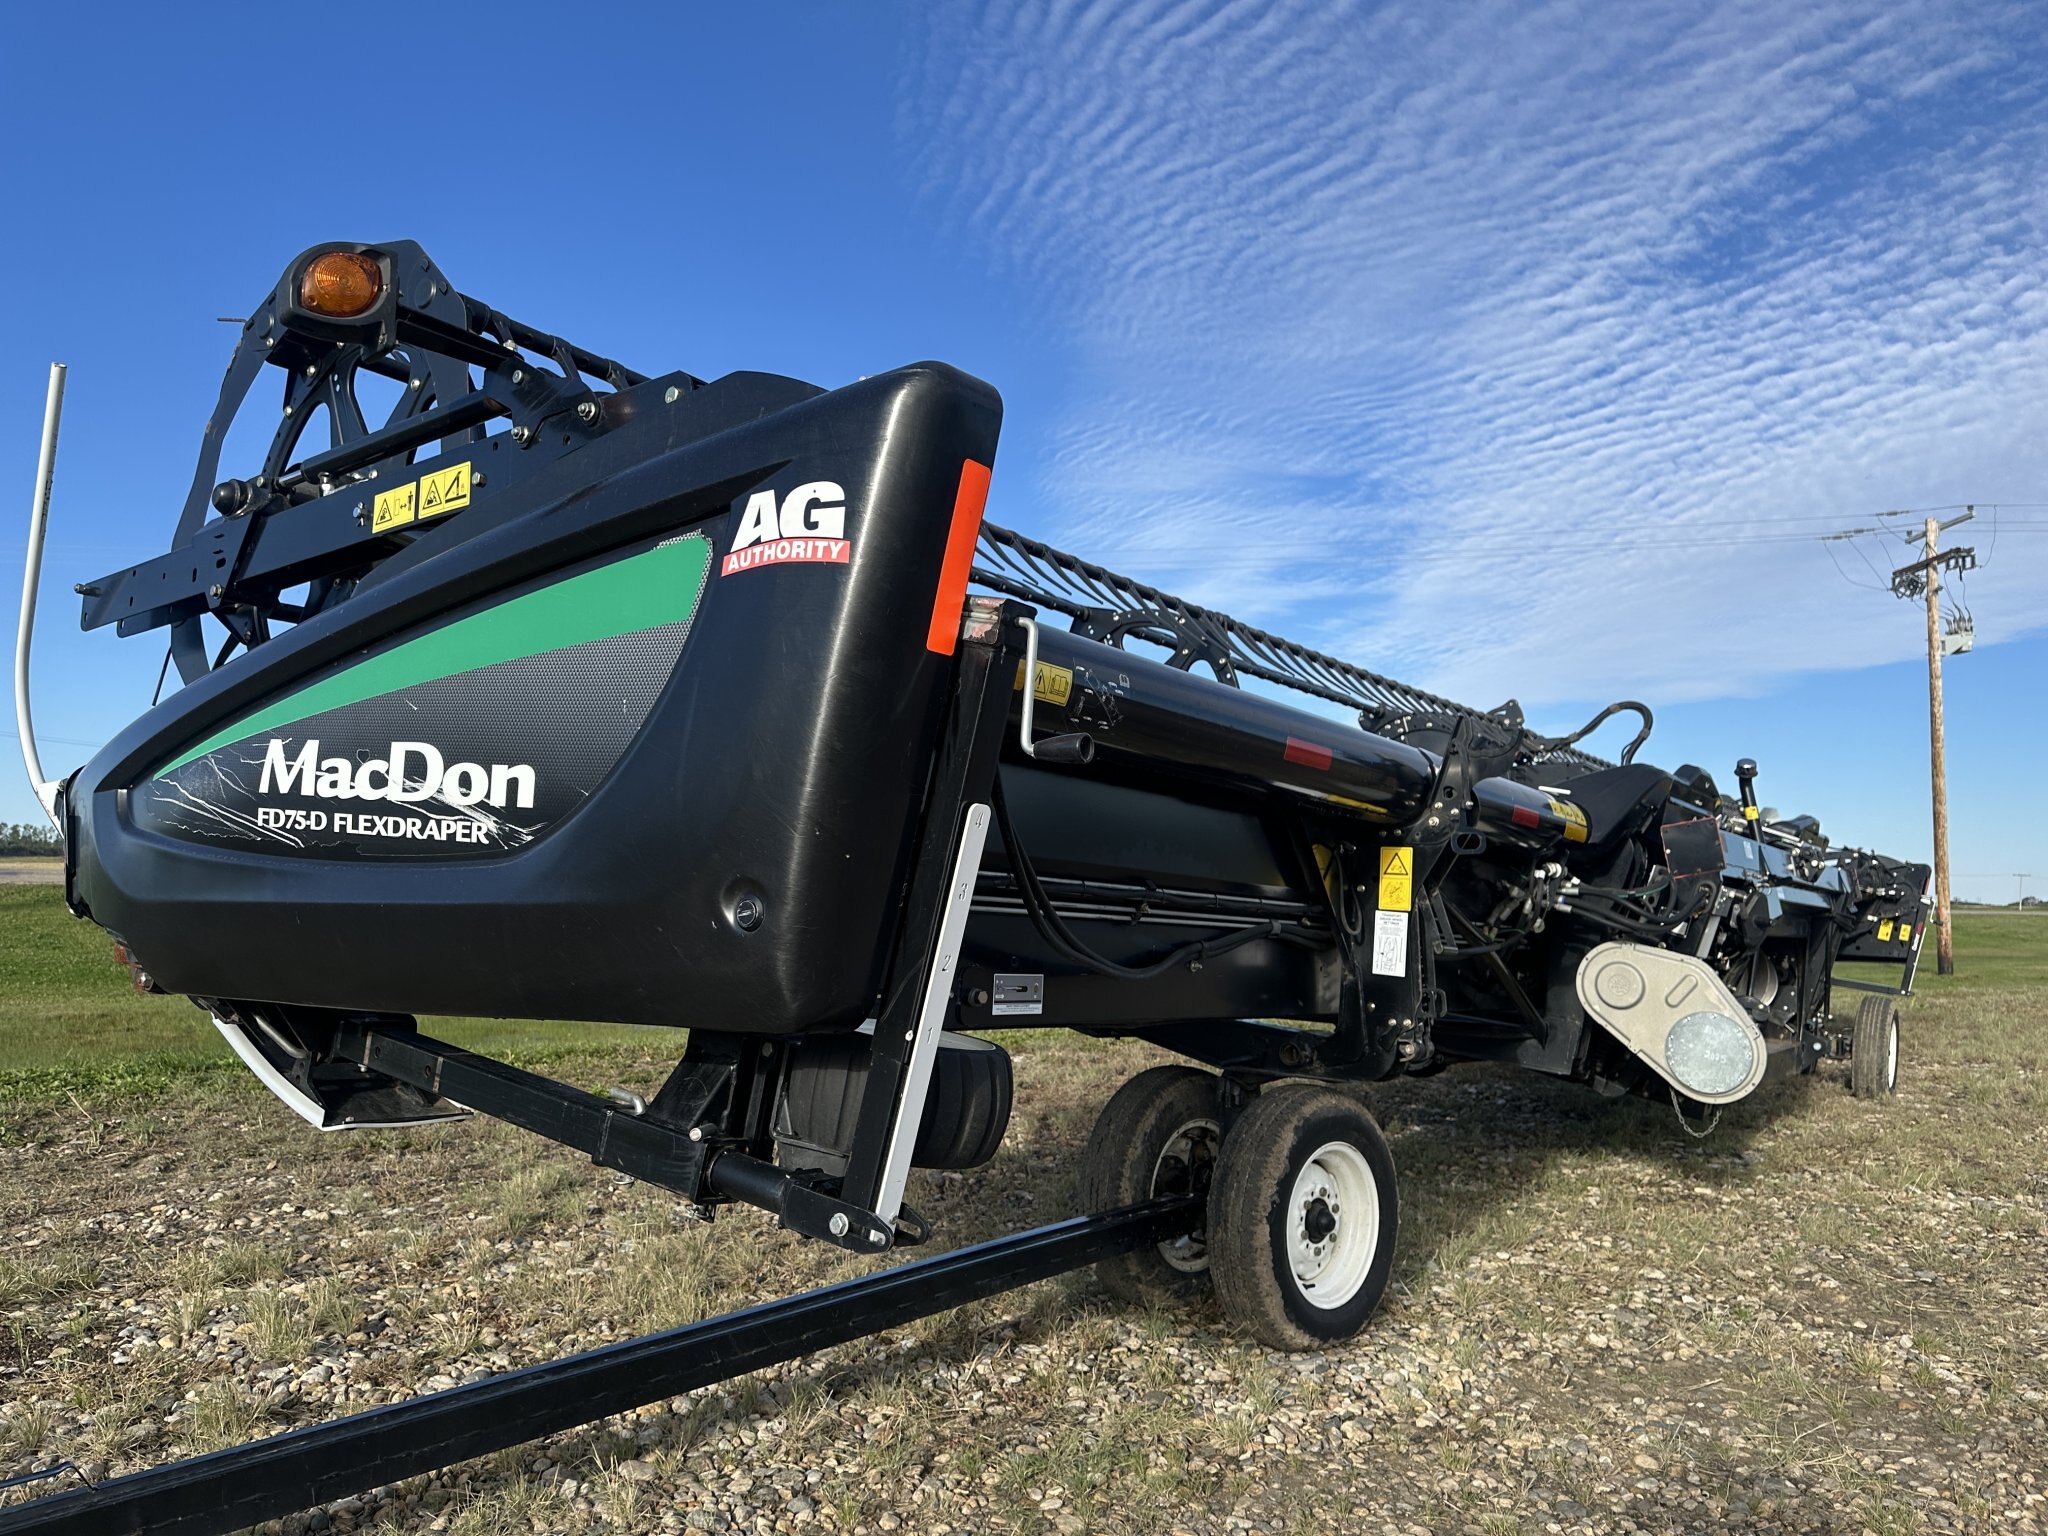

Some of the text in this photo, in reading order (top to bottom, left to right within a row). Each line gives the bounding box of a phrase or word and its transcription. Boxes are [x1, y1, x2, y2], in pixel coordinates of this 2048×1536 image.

[730, 481, 846, 553] AG
[727, 541, 845, 572] AUTHORITY
[258, 738, 536, 808] MacDon
[333, 813, 489, 845] FLEXDRAPER
[976, 812, 984, 830] 4
[959, 883, 968, 901] 3
[942, 955, 951, 972] 2
